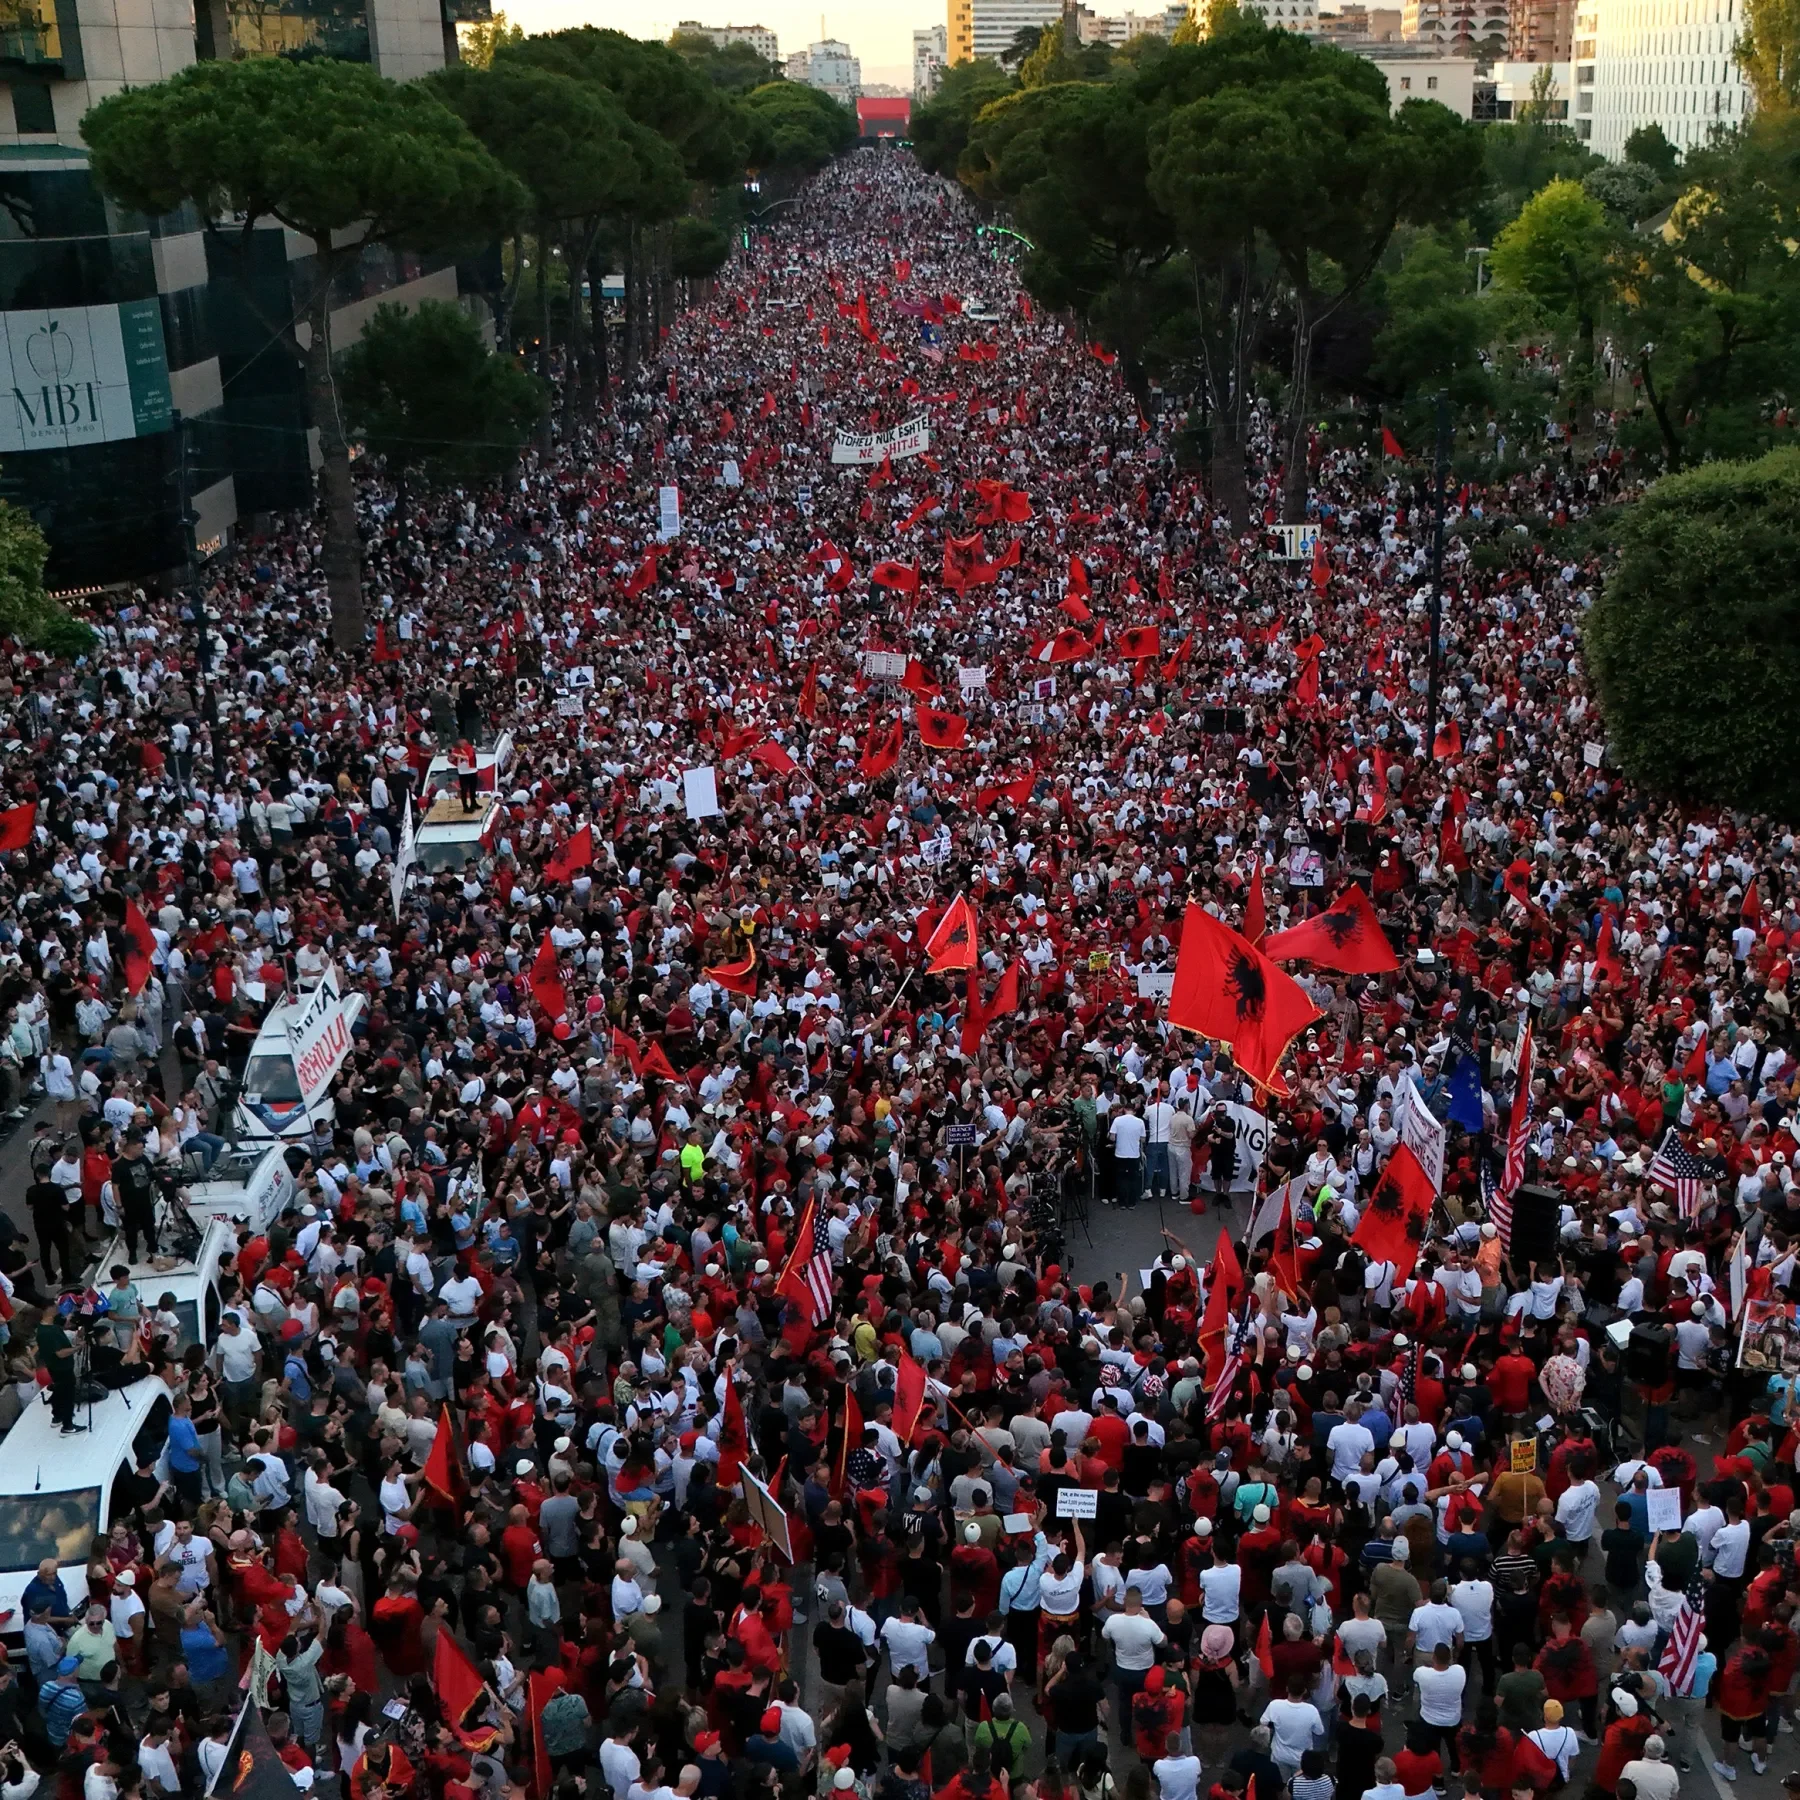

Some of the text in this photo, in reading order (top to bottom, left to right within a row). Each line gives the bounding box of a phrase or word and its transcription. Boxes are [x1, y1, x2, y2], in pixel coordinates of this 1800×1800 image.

[11, 381, 102, 429] MBT
[30, 428, 71, 438] DENTAL
[833, 432, 873, 447] ATDHEU
[875, 432, 896, 445] NUK
[882, 435, 919, 456] SHITJE
